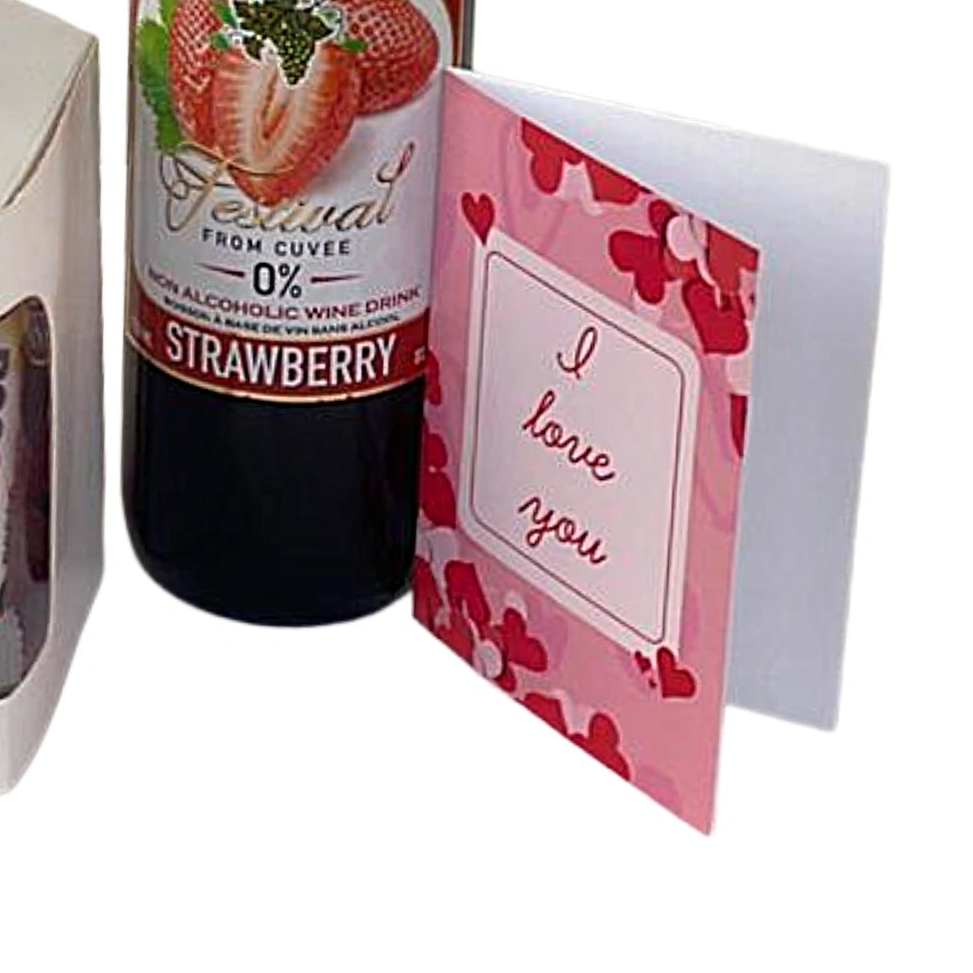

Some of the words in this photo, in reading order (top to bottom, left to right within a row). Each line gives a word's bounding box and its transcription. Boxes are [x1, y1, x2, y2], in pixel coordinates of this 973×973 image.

[159, 141, 415, 232] Festival
[202, 228, 262, 253] FROM
[274, 239, 351, 257] CUVEE
[148, 266, 179, 294] NON
[182, 285, 299, 320] ALCOHOLIC
[305, 303, 362, 320] WINE
[365, 286, 421, 314] DRINK
[253, 262, 302, 298] 0%
[166, 320, 397, 388] STRAWBERRY
[556, 326, 598, 380] I
[521, 389, 616, 482] love
[518, 495, 607, 564] you
